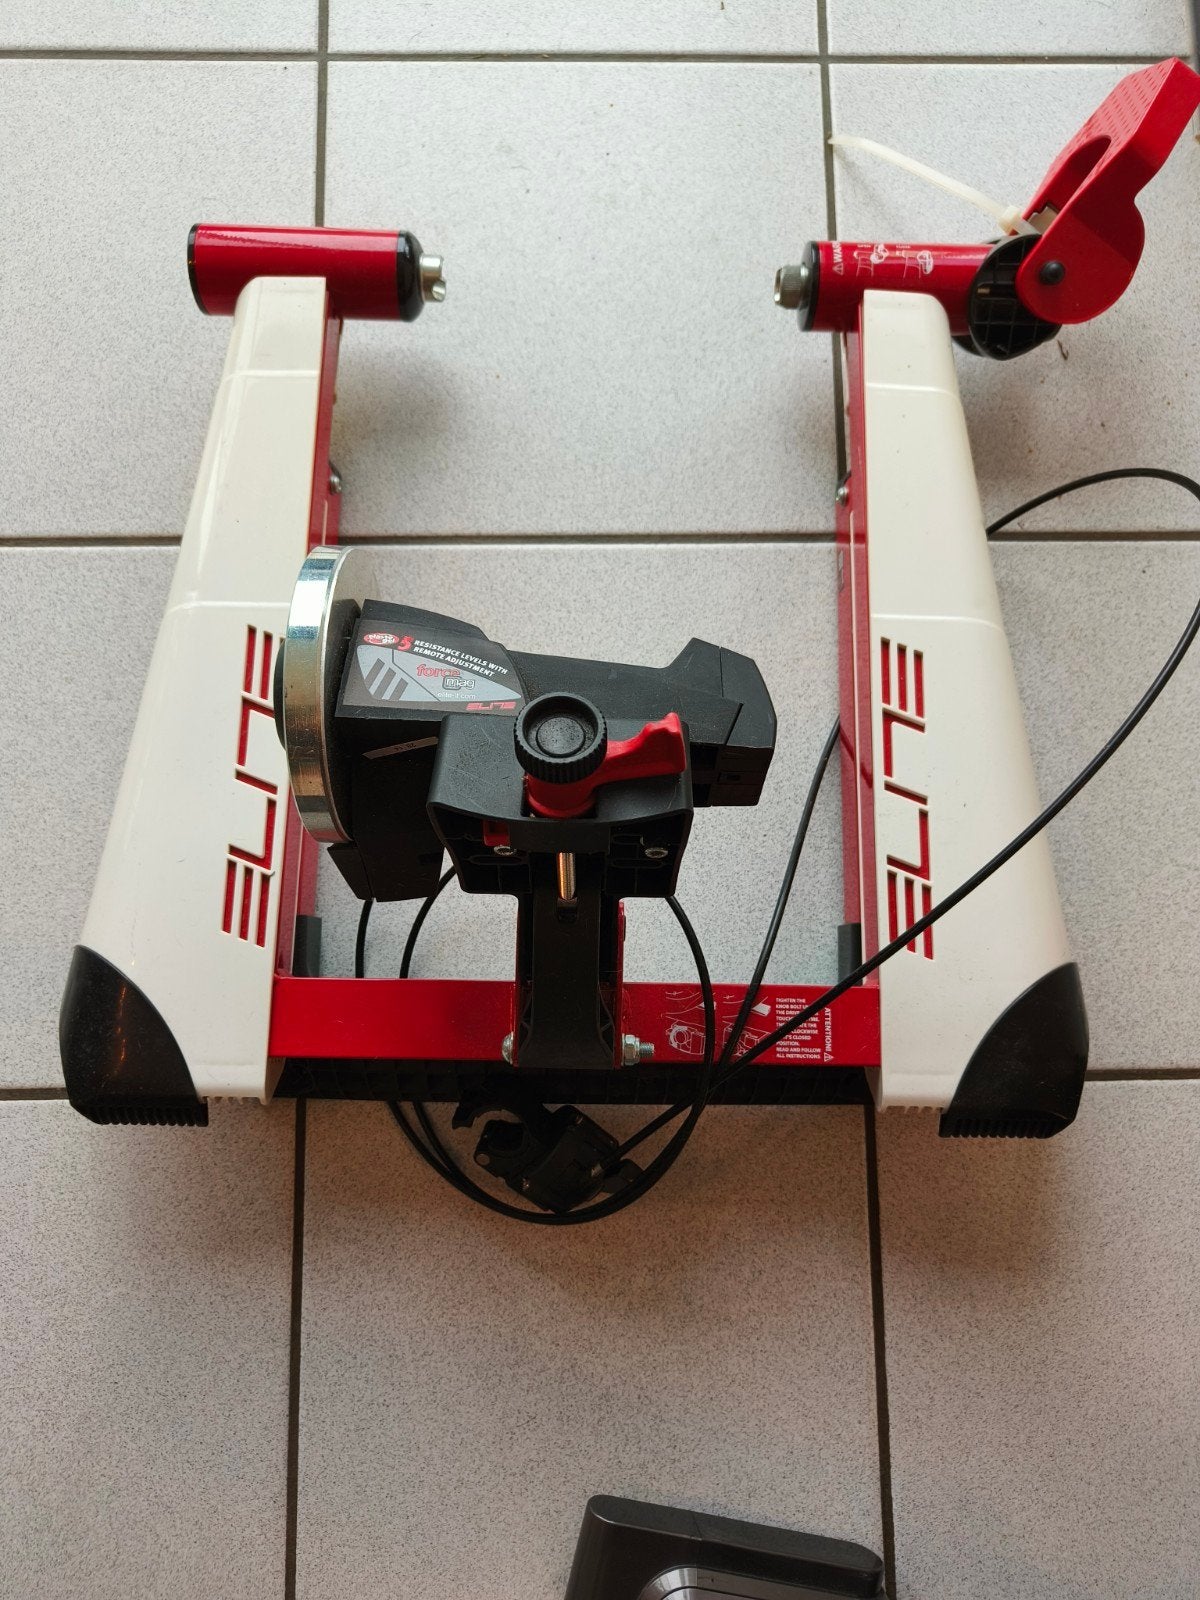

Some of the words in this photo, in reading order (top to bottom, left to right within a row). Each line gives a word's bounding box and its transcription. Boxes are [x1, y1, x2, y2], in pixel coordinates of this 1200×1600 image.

[397, 635, 415, 651] 5
[413, 647, 445, 659] REMOTE
[446, 656, 496, 677] ADJUSTMENT
[414, 640, 461, 657] RESISTANCE
[461, 653, 488, 666] LEVELS
[488, 663, 508, 675] WITH
[416, 663, 460, 677] force
[445, 678, 475, 690] mag
